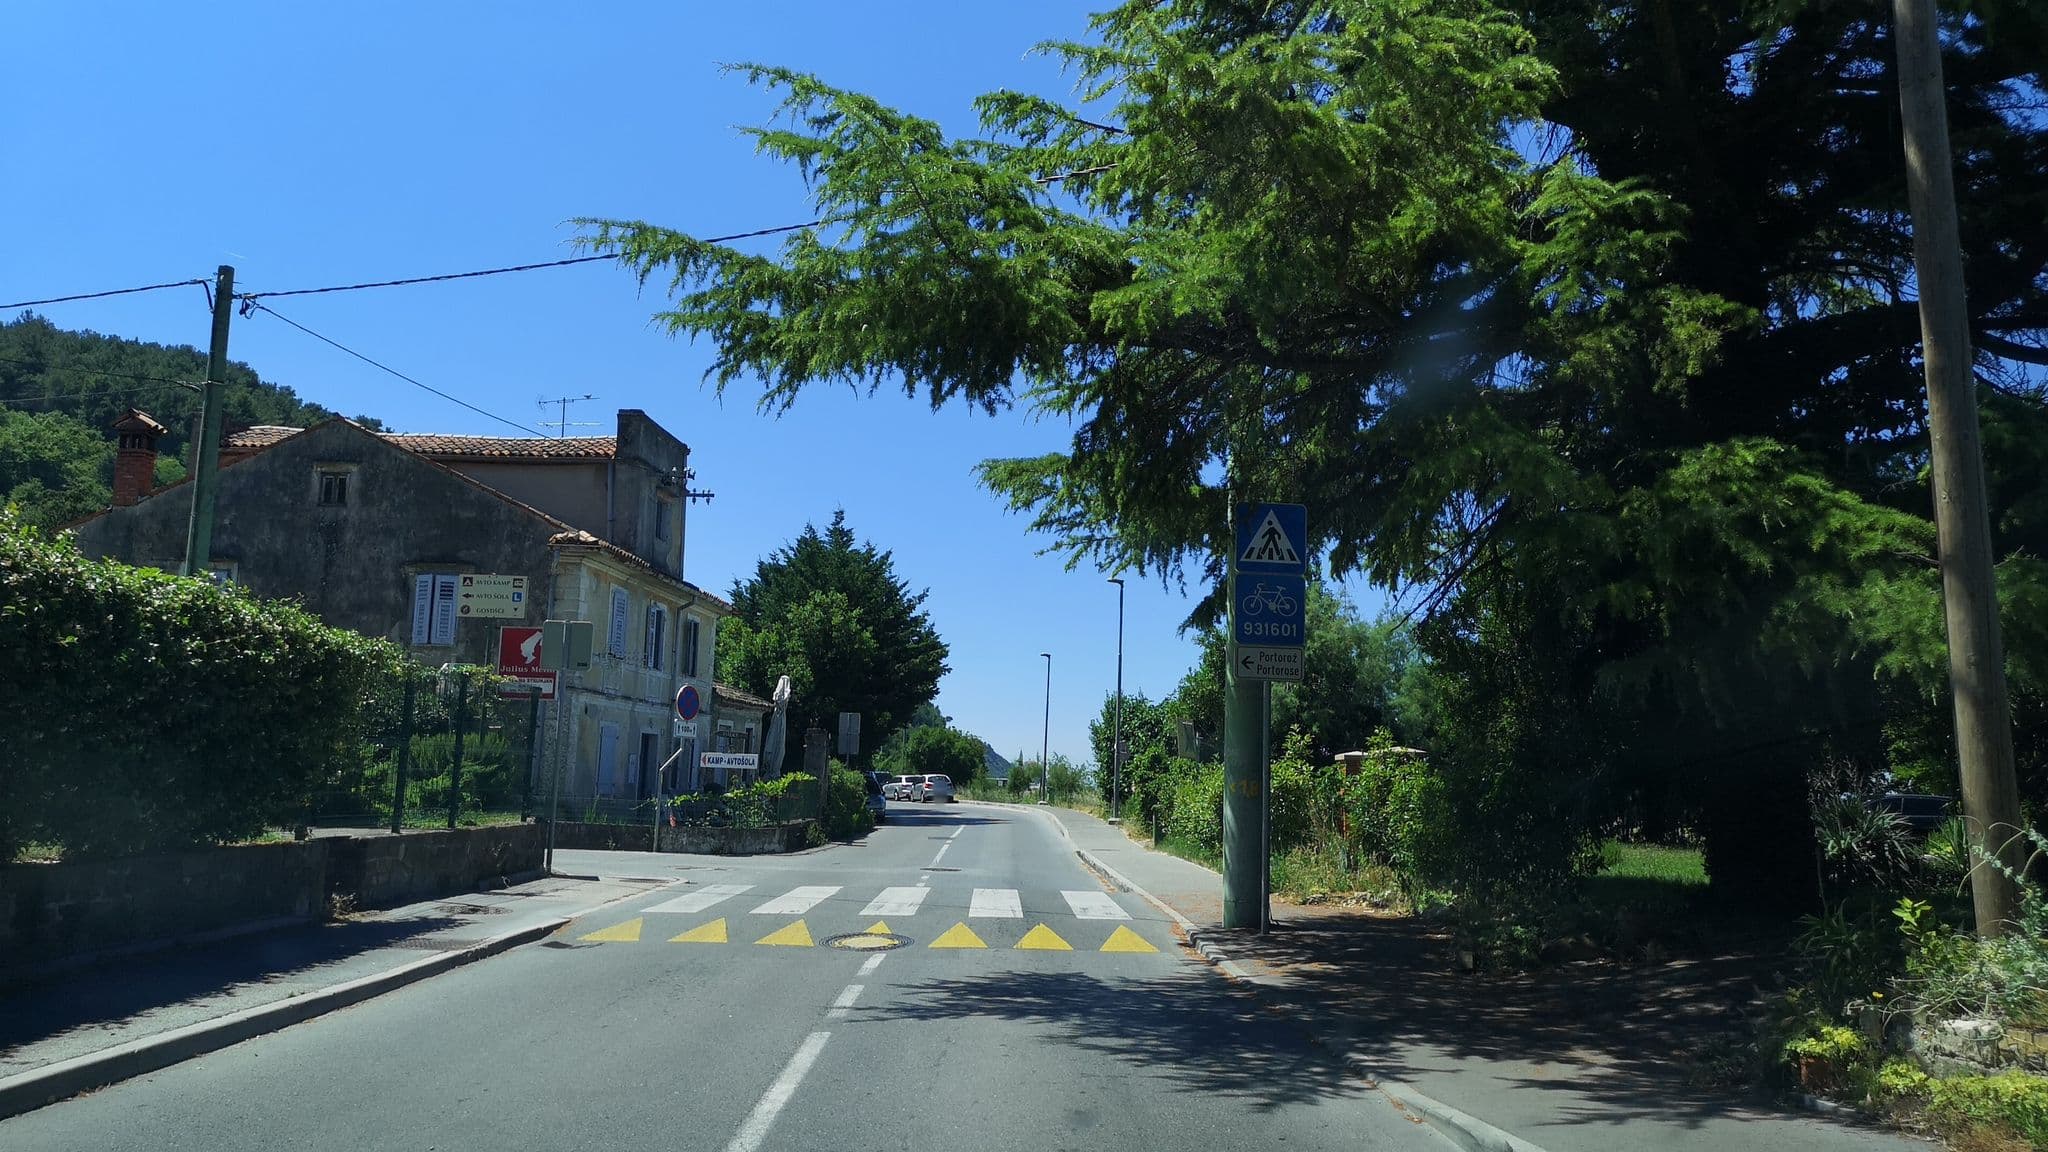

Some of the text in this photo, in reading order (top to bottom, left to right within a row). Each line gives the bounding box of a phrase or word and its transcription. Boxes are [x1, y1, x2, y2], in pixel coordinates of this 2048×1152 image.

[1243, 622, 1297, 637] 931601
[1259, 651, 1298, 663] Portorož
[1257, 664, 1299, 676] Portorose
